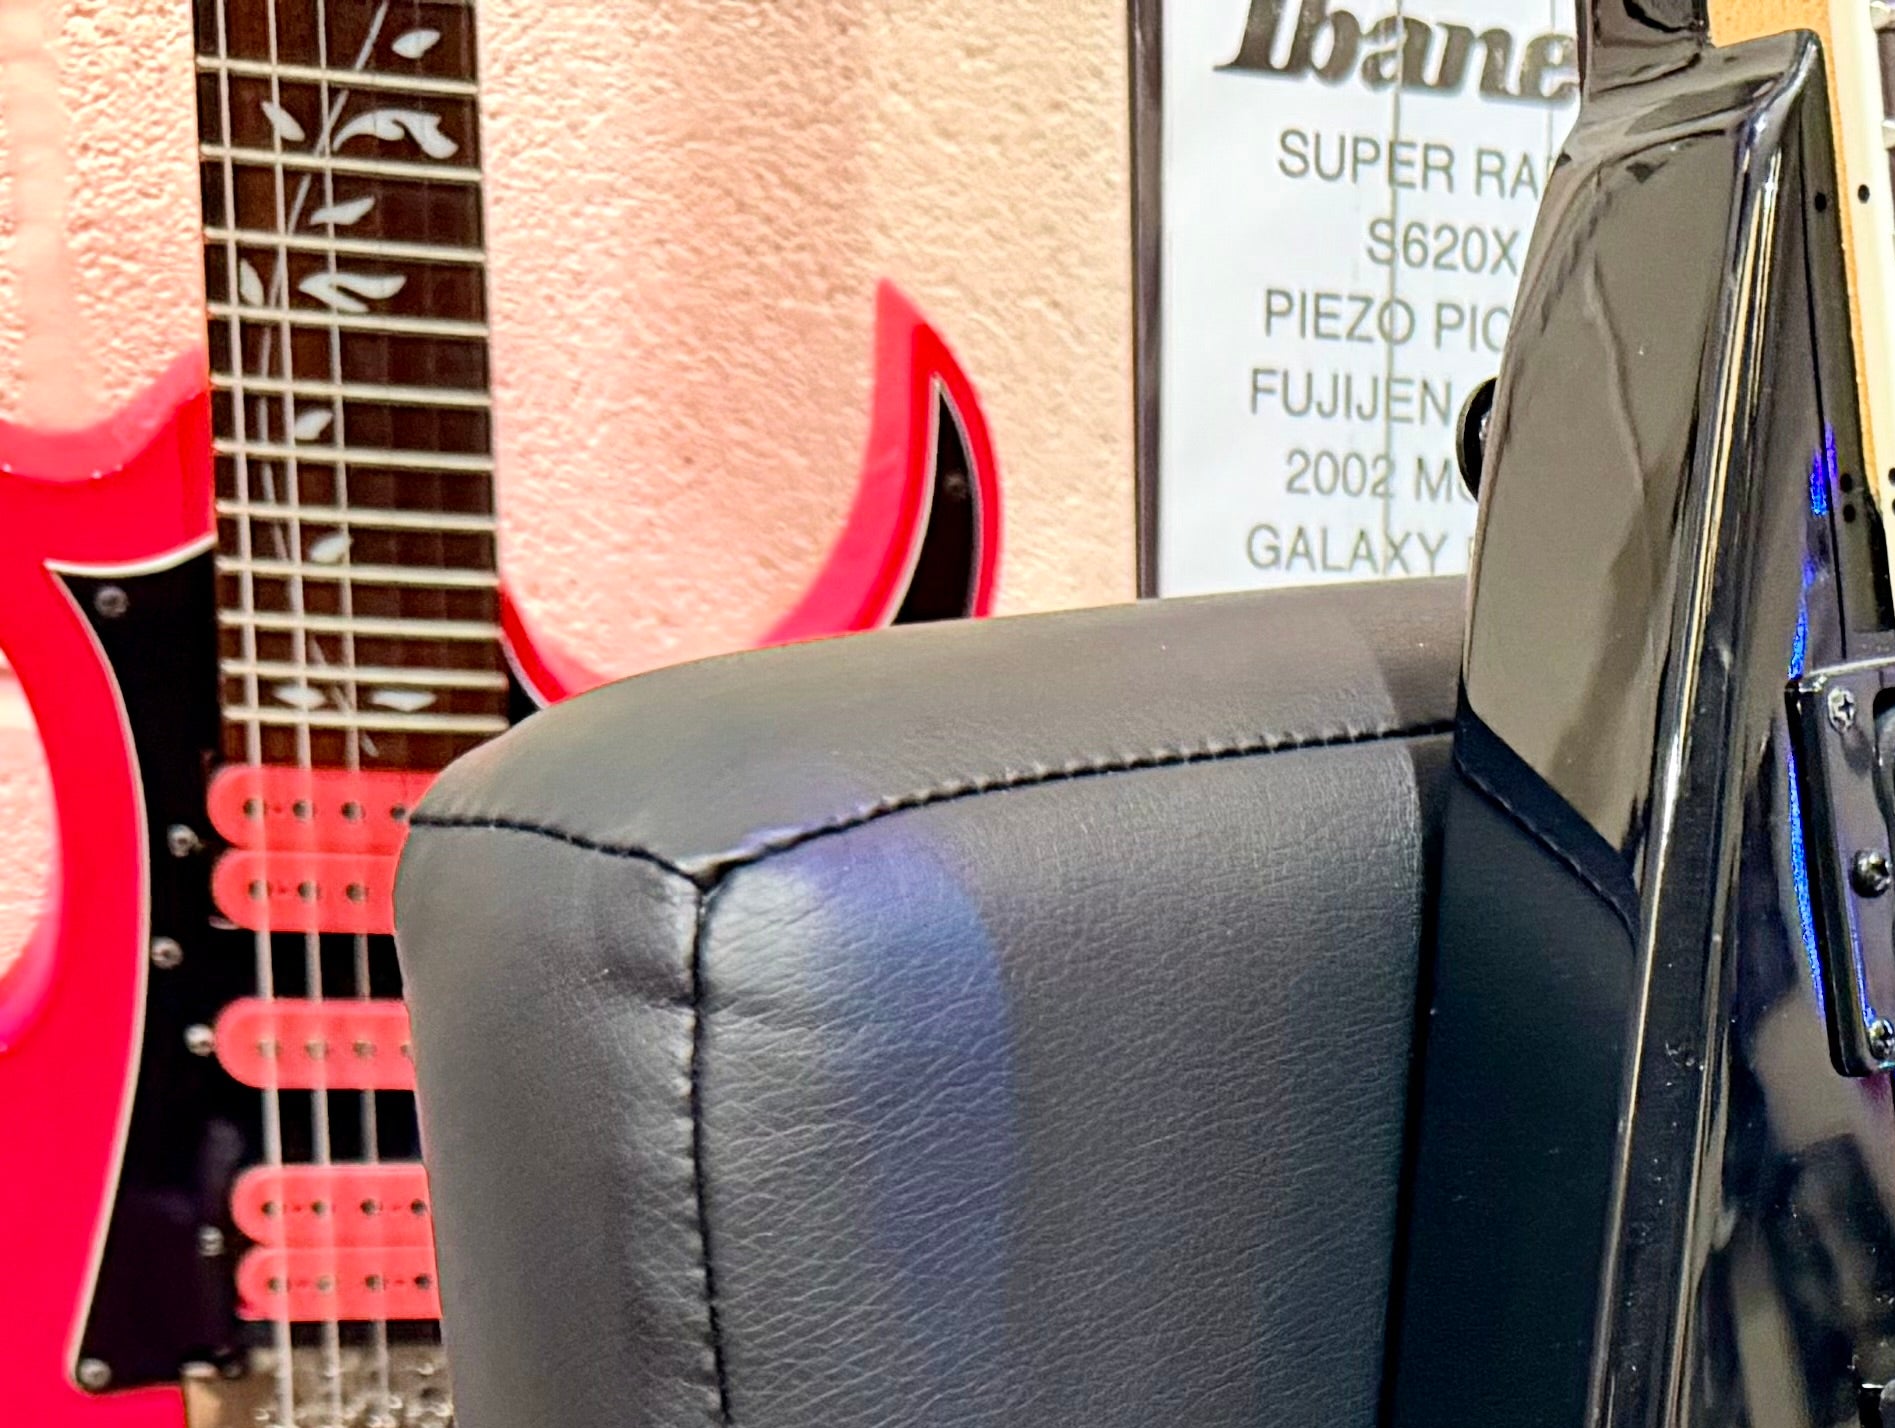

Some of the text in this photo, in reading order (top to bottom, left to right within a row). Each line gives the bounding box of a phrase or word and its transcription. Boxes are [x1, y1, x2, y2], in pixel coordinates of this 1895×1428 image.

[1277, 129, 1455, 194] SUPER
[1366, 218, 1519, 276] S620X
[1265, 289, 1417, 345] PIEZO
[1251, 368, 1453, 426] FUJIJEN
[1285, 449, 1396, 499] 2002
[1245, 523, 1448, 573] GALAXY
